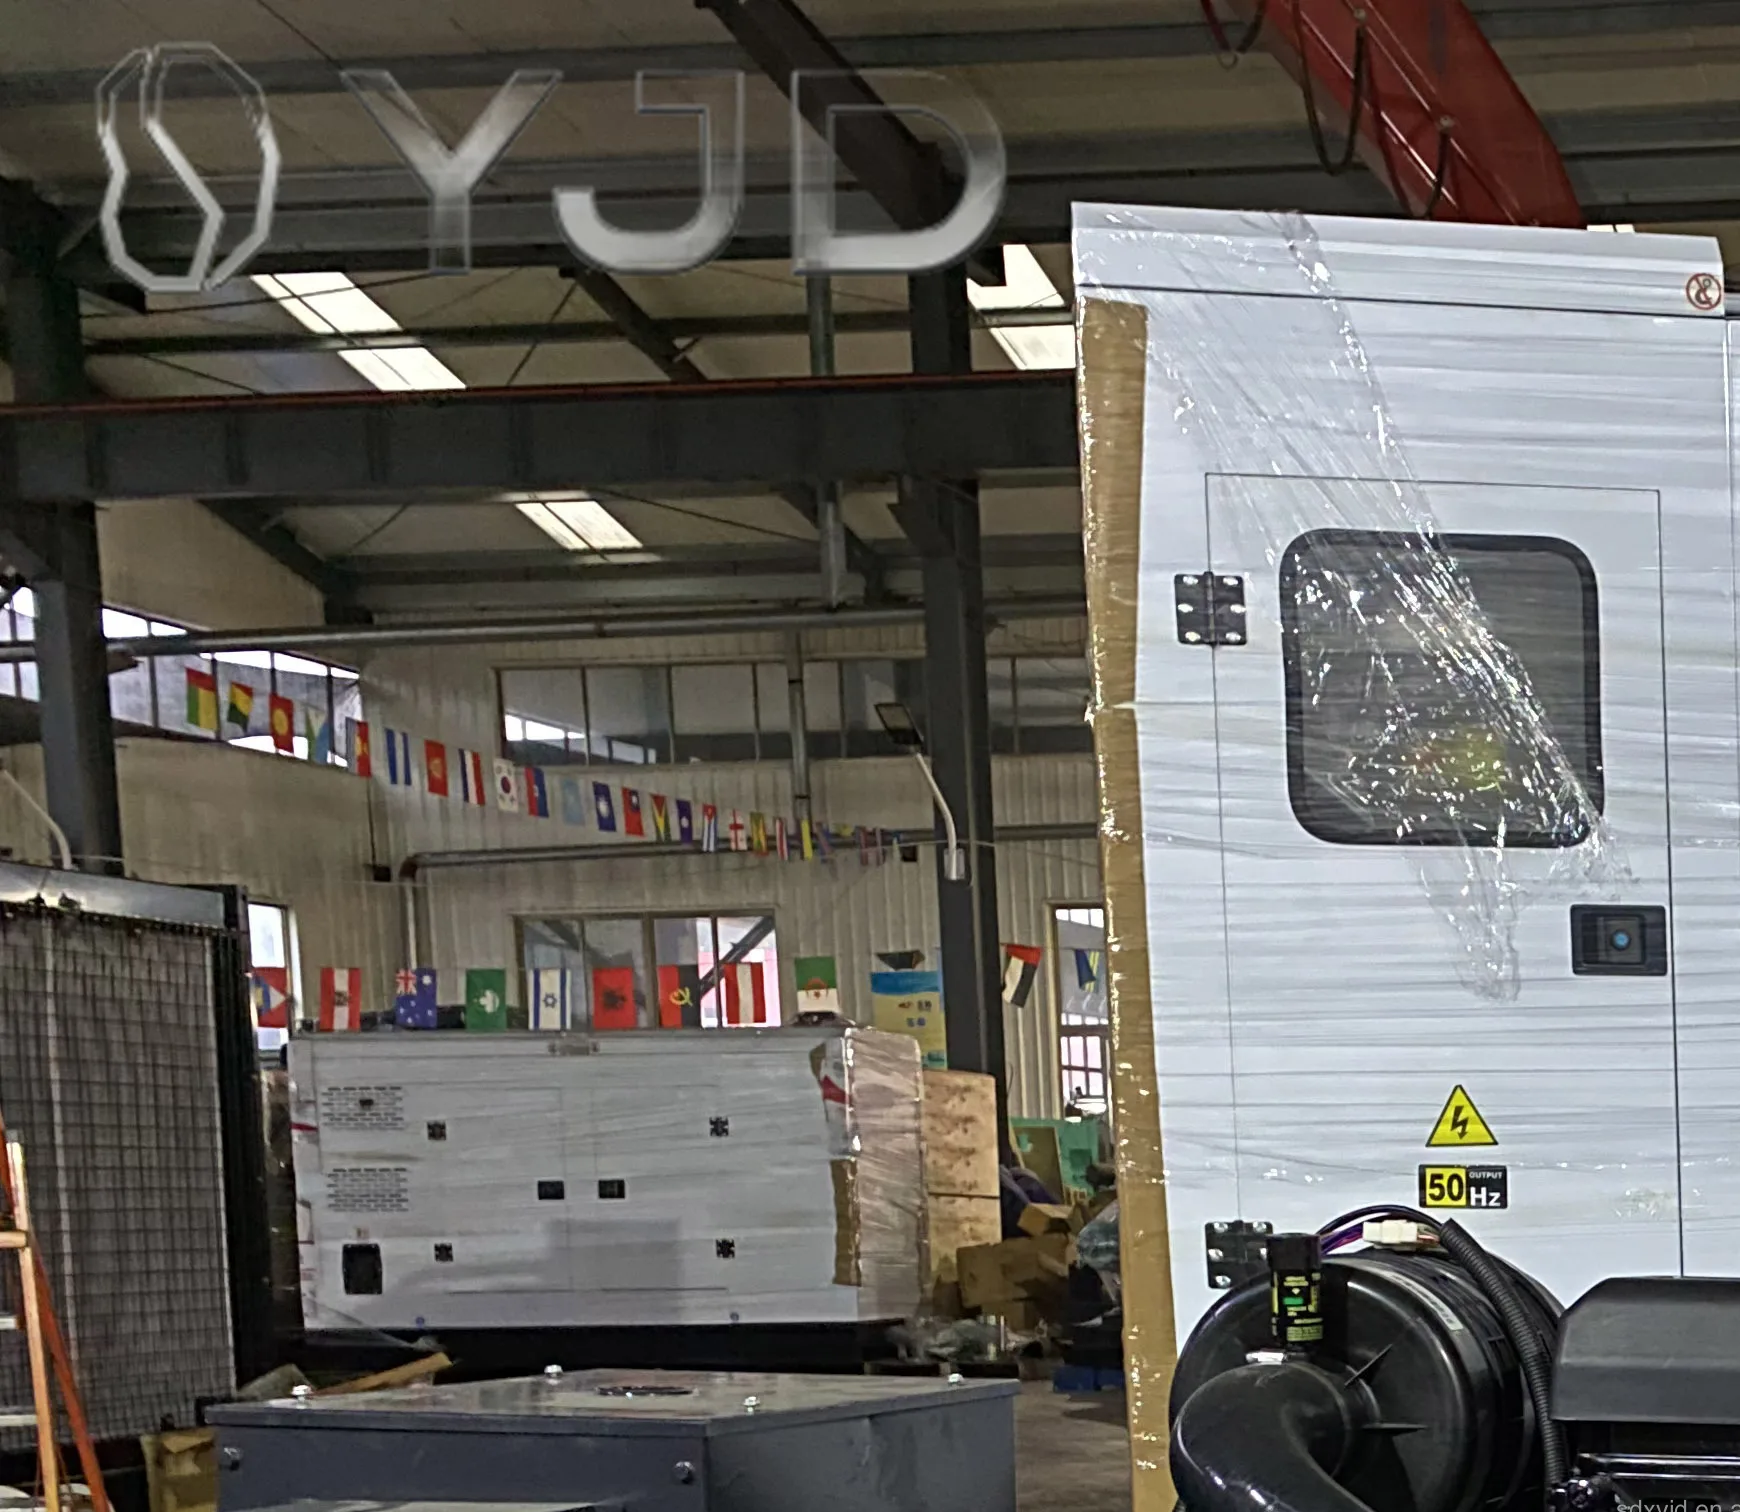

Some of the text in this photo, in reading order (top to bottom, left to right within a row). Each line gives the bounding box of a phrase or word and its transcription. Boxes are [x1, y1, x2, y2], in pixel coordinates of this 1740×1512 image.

[1468, 1171, 1502, 1179] OUTPUT
[1428, 1173, 1501, 1206] 50 Hz
